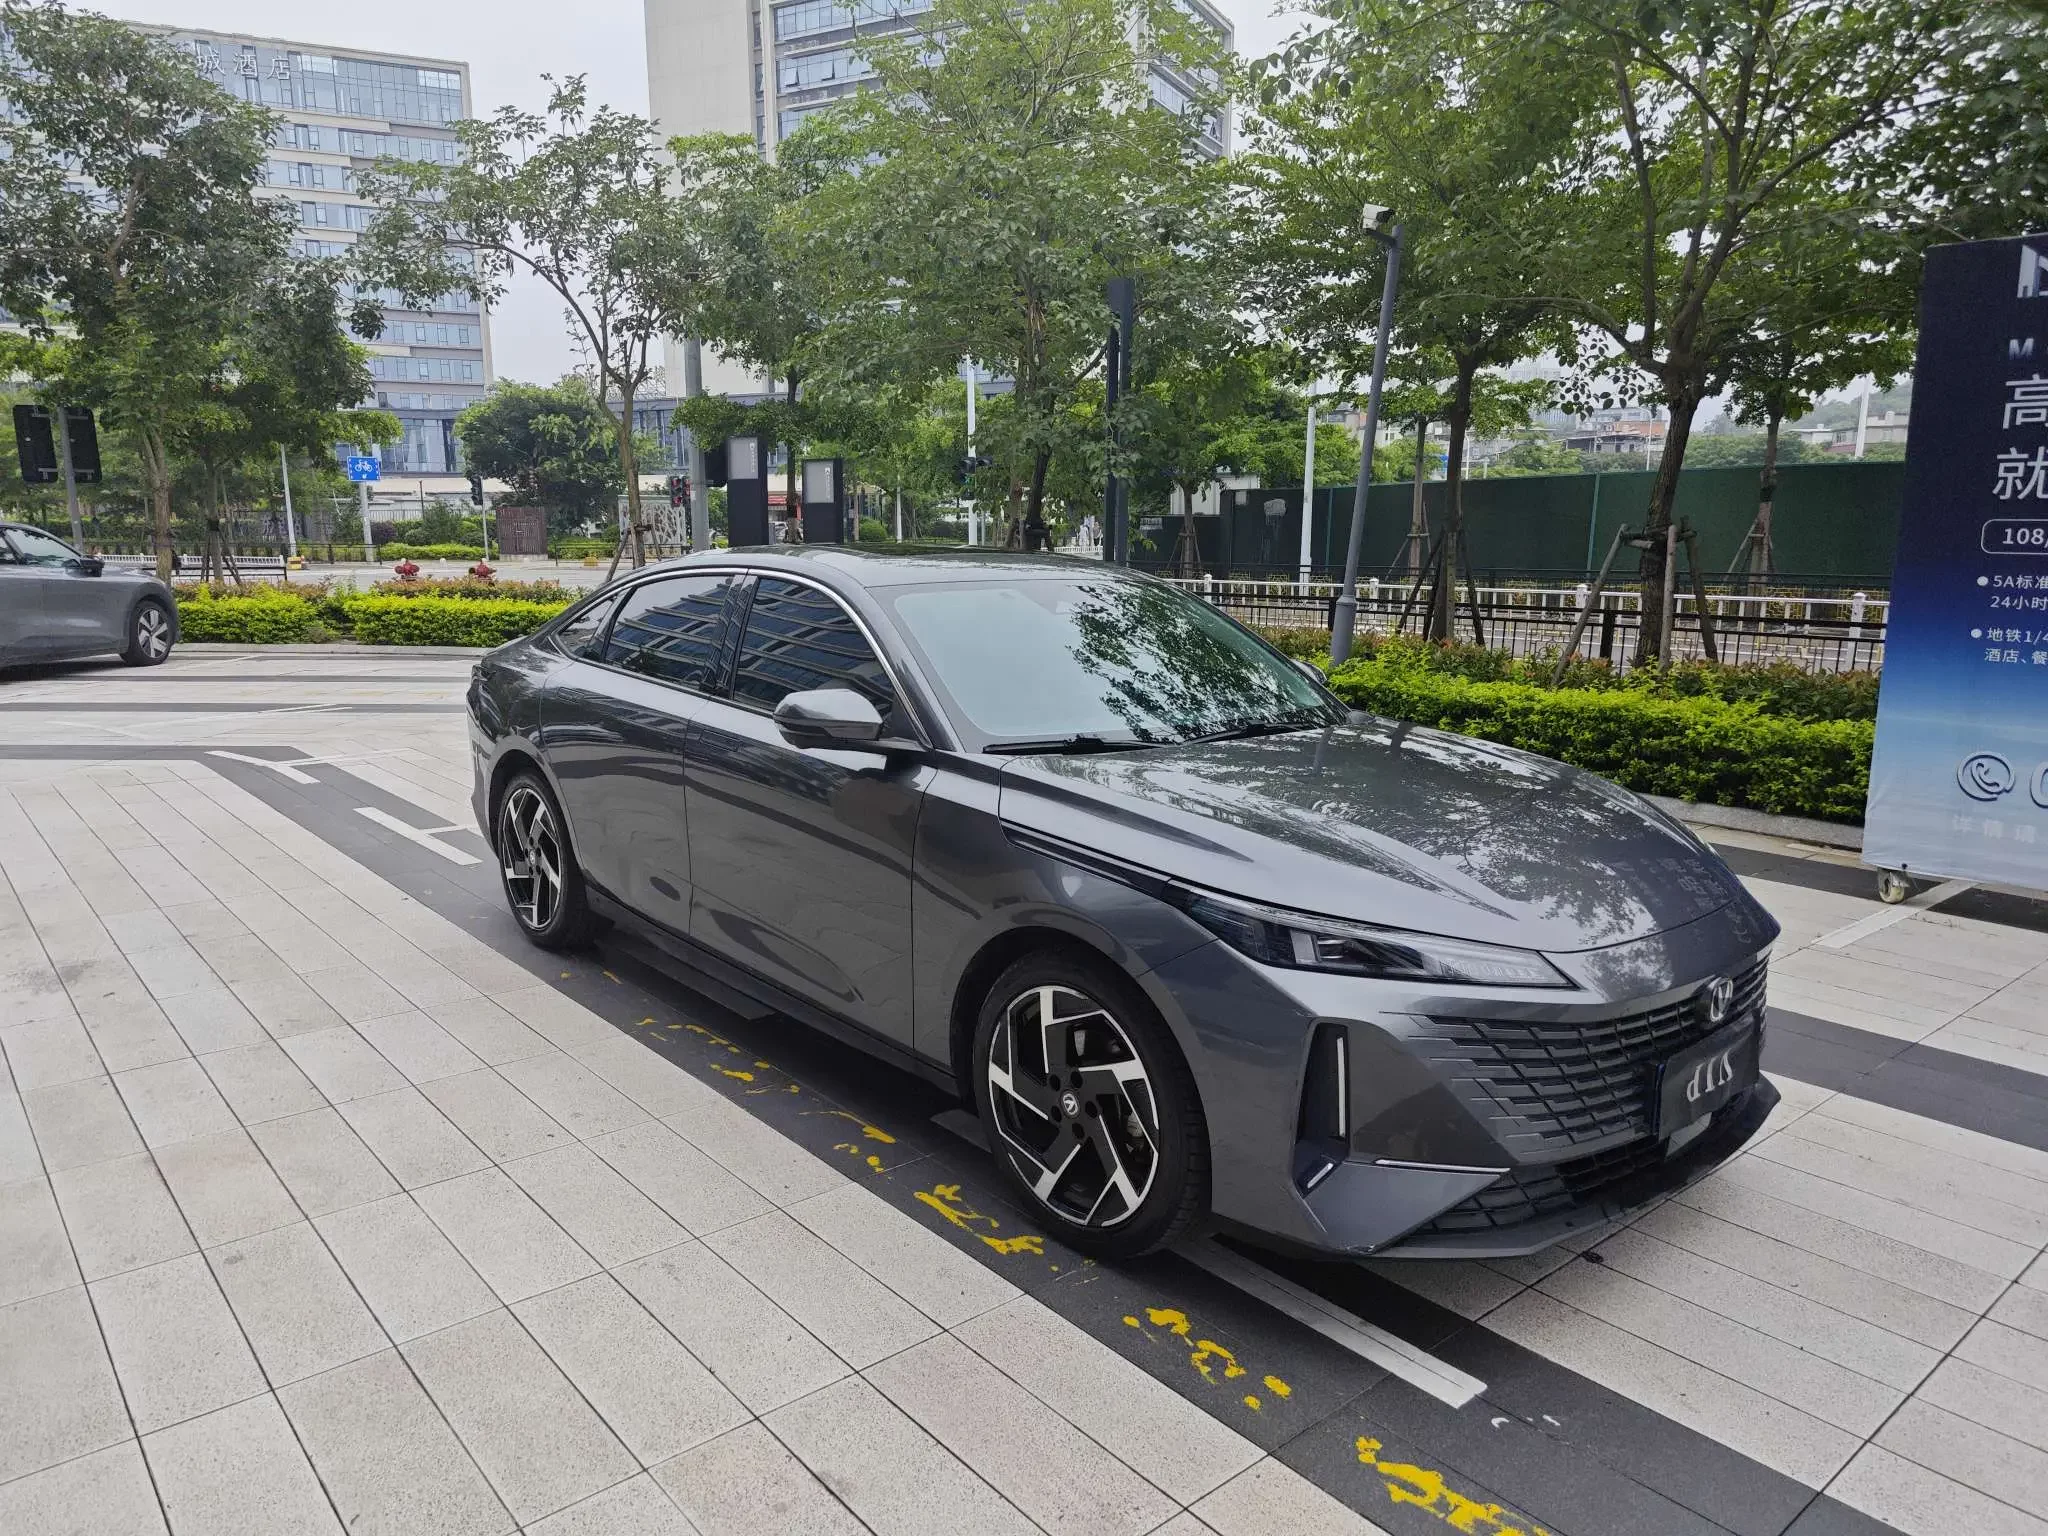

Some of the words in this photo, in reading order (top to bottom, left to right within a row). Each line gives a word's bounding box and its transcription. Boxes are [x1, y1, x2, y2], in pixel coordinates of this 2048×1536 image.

[2003, 373, 2048, 429] 高
[1992, 446, 2048, 499] 就
[2002, 528, 2048, 548] 108
[1993, 575, 2048, 589] 5A标准
[1990, 596, 2048, 610] 24小时
